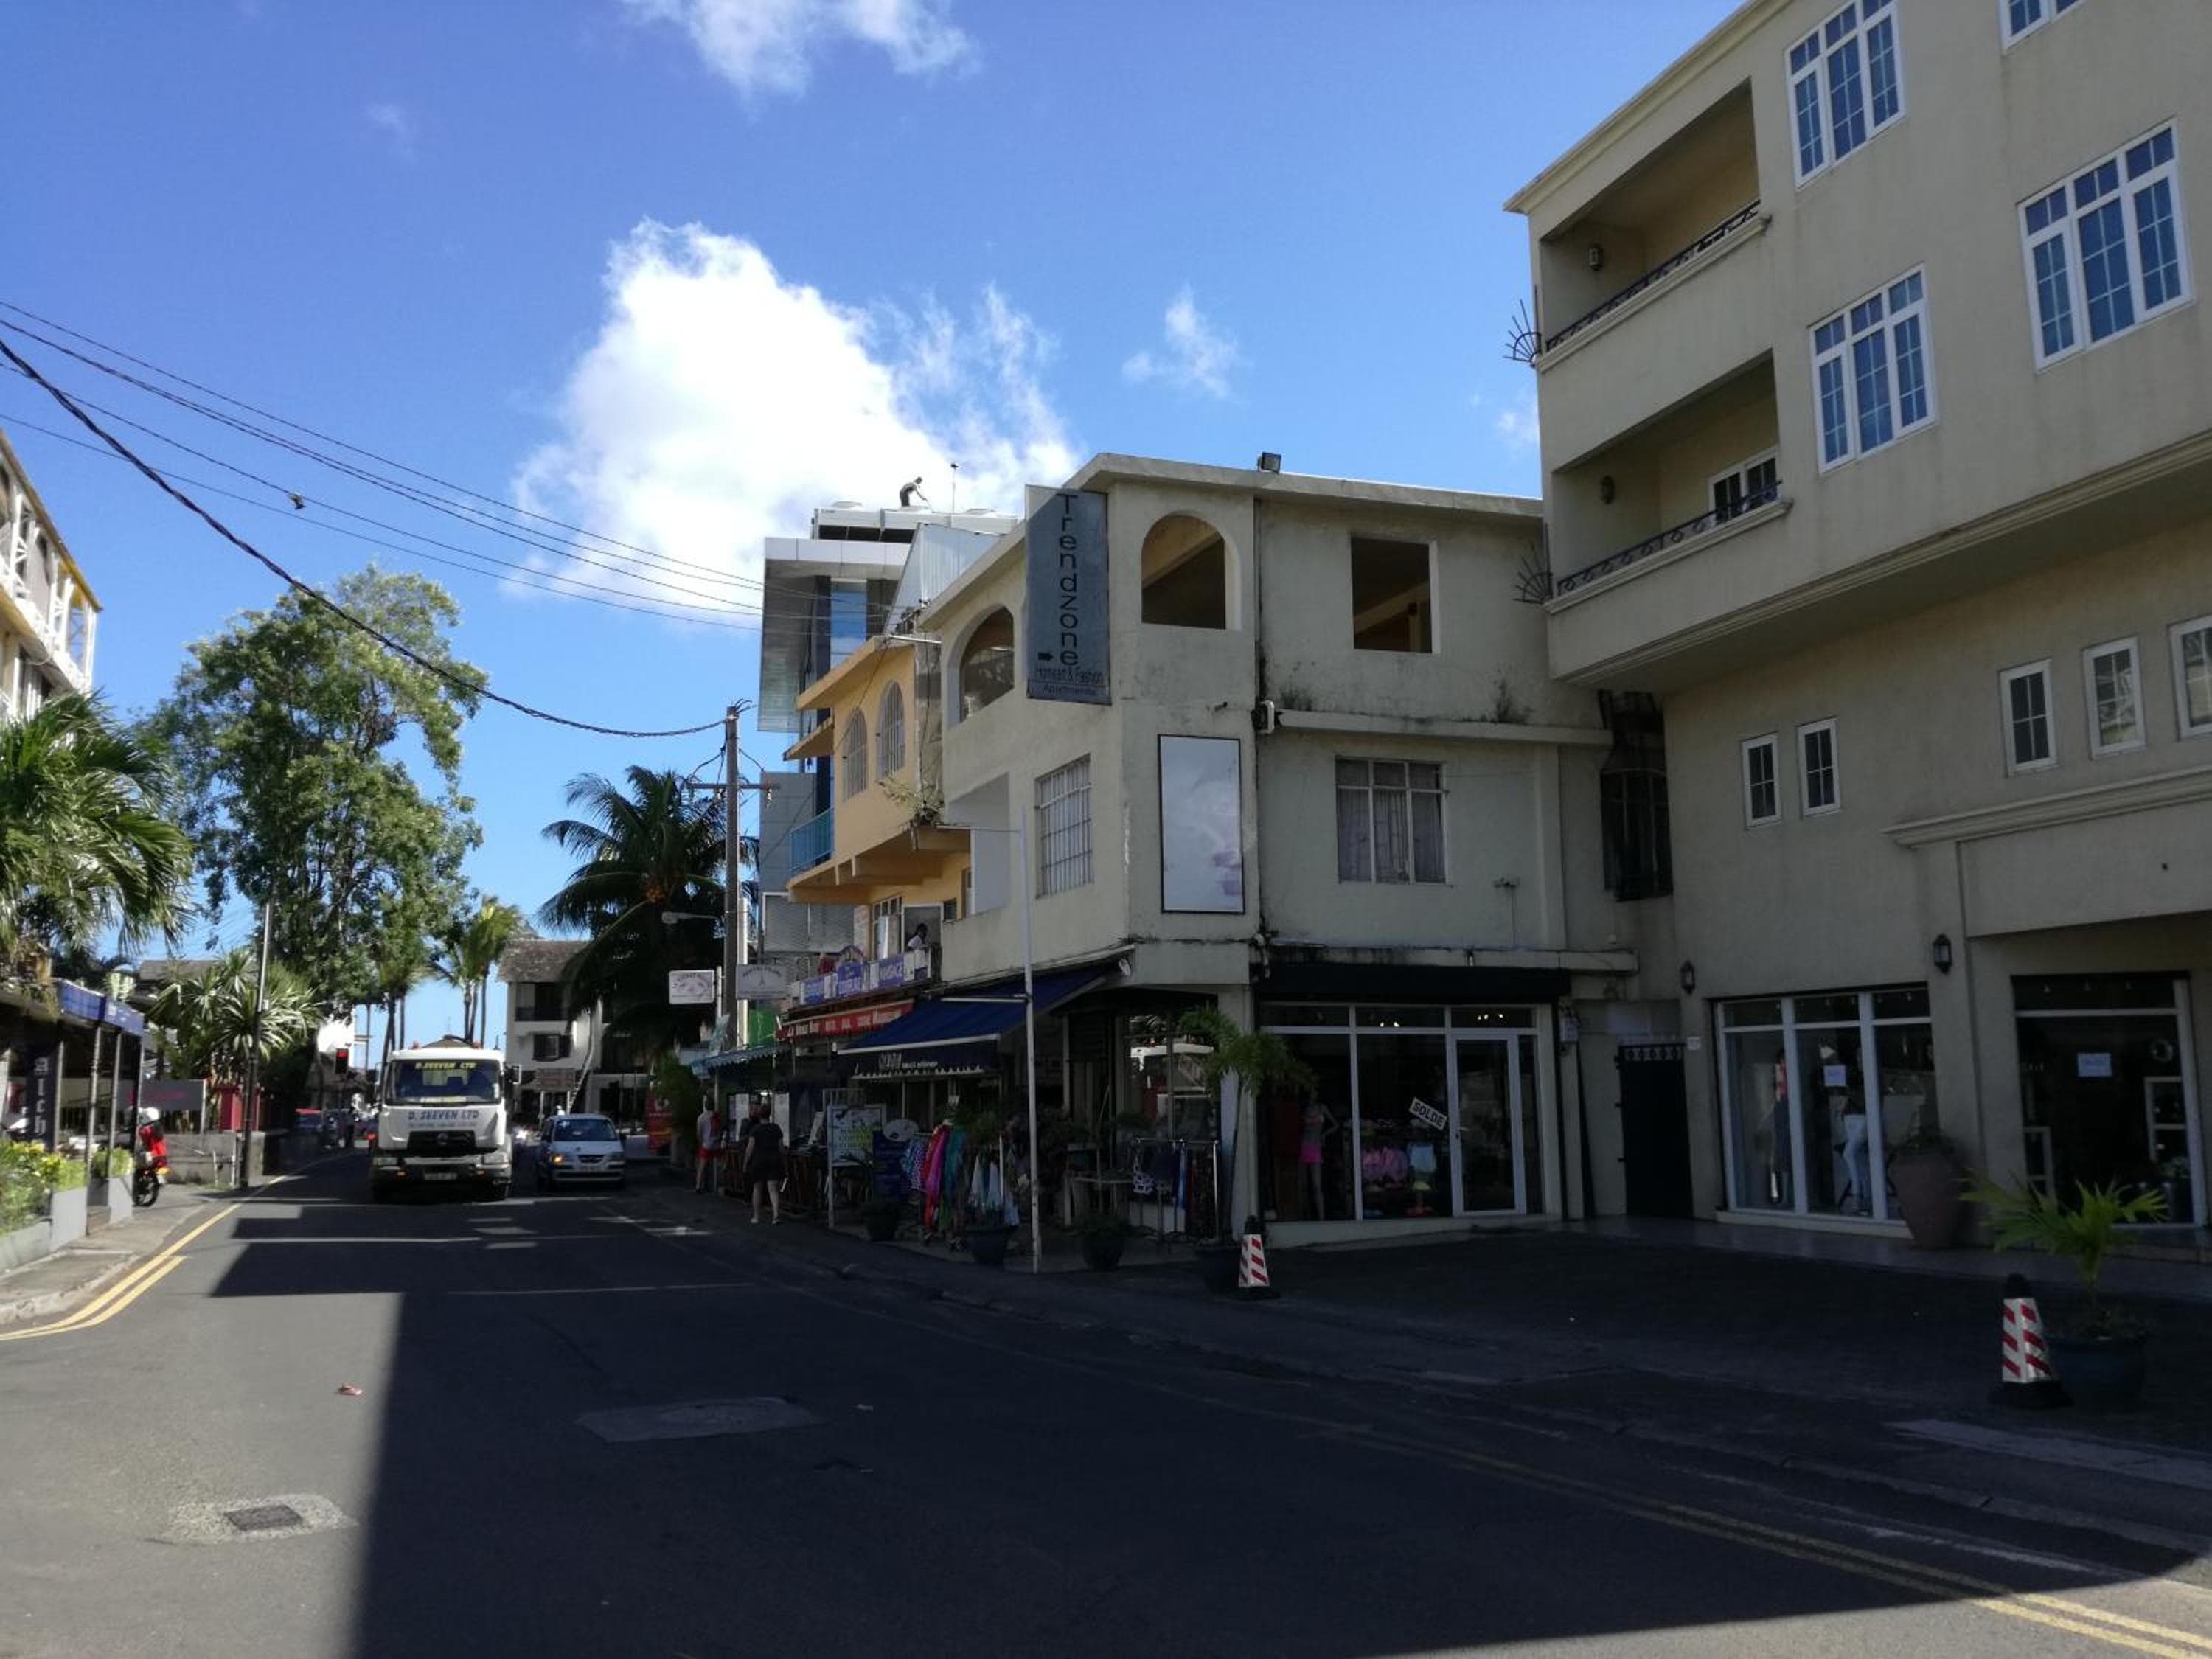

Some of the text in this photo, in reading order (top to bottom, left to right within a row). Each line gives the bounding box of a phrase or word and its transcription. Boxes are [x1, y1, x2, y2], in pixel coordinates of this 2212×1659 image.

[1057, 493, 1079, 667] Trendzone
[461, 1110, 479, 1119] LTD
[1413, 1102, 1444, 1127] SOLDE
